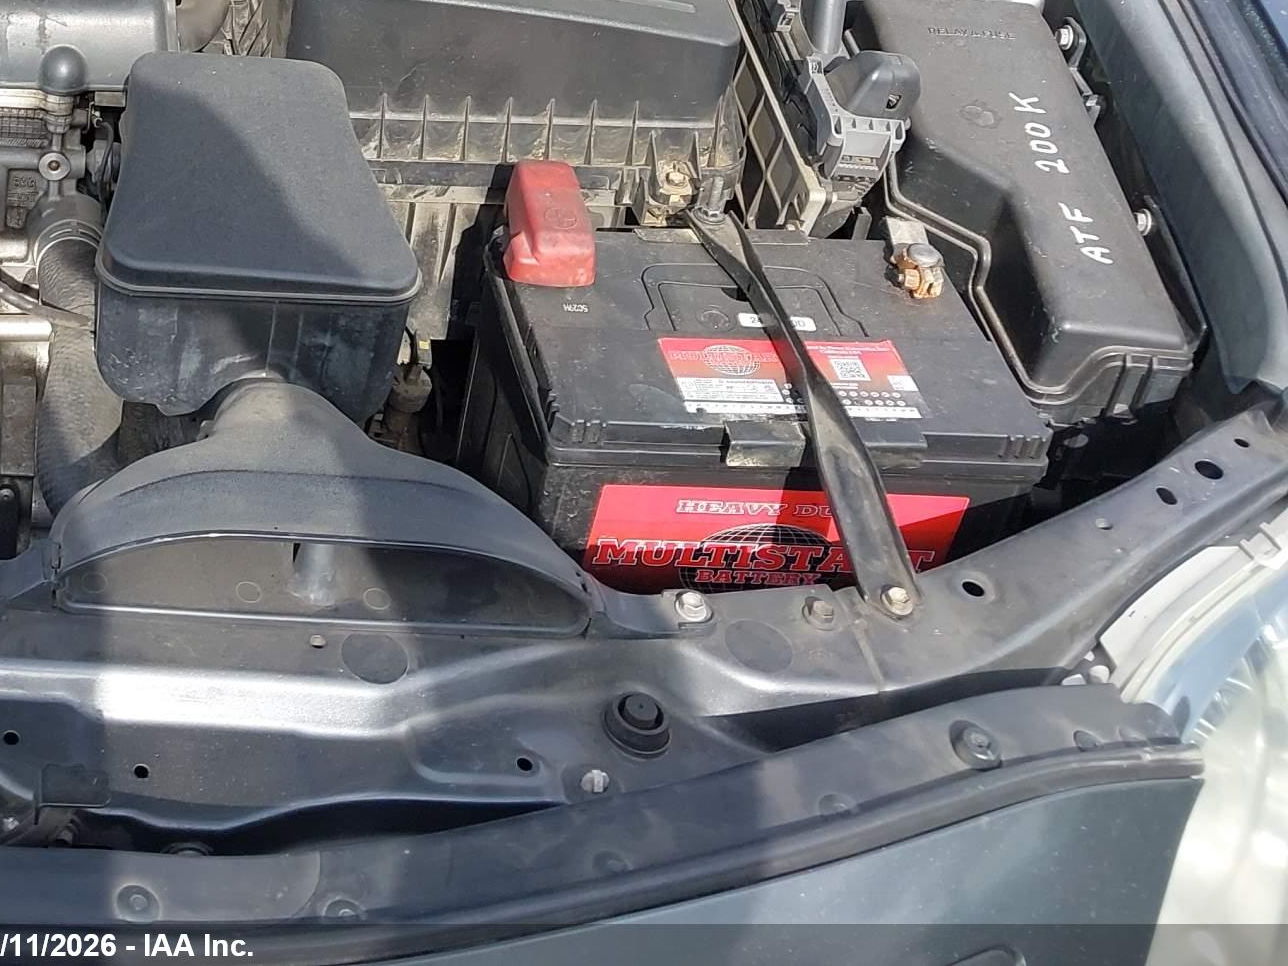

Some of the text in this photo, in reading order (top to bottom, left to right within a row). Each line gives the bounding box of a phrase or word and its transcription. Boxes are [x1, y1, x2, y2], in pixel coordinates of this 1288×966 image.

[1057, 202, 1114, 265] ATF
[675, 499, 789, 517] HEAVY
[592, 537, 935, 574] MULTISTAT
[695, 569, 821, 585] BATTERY
